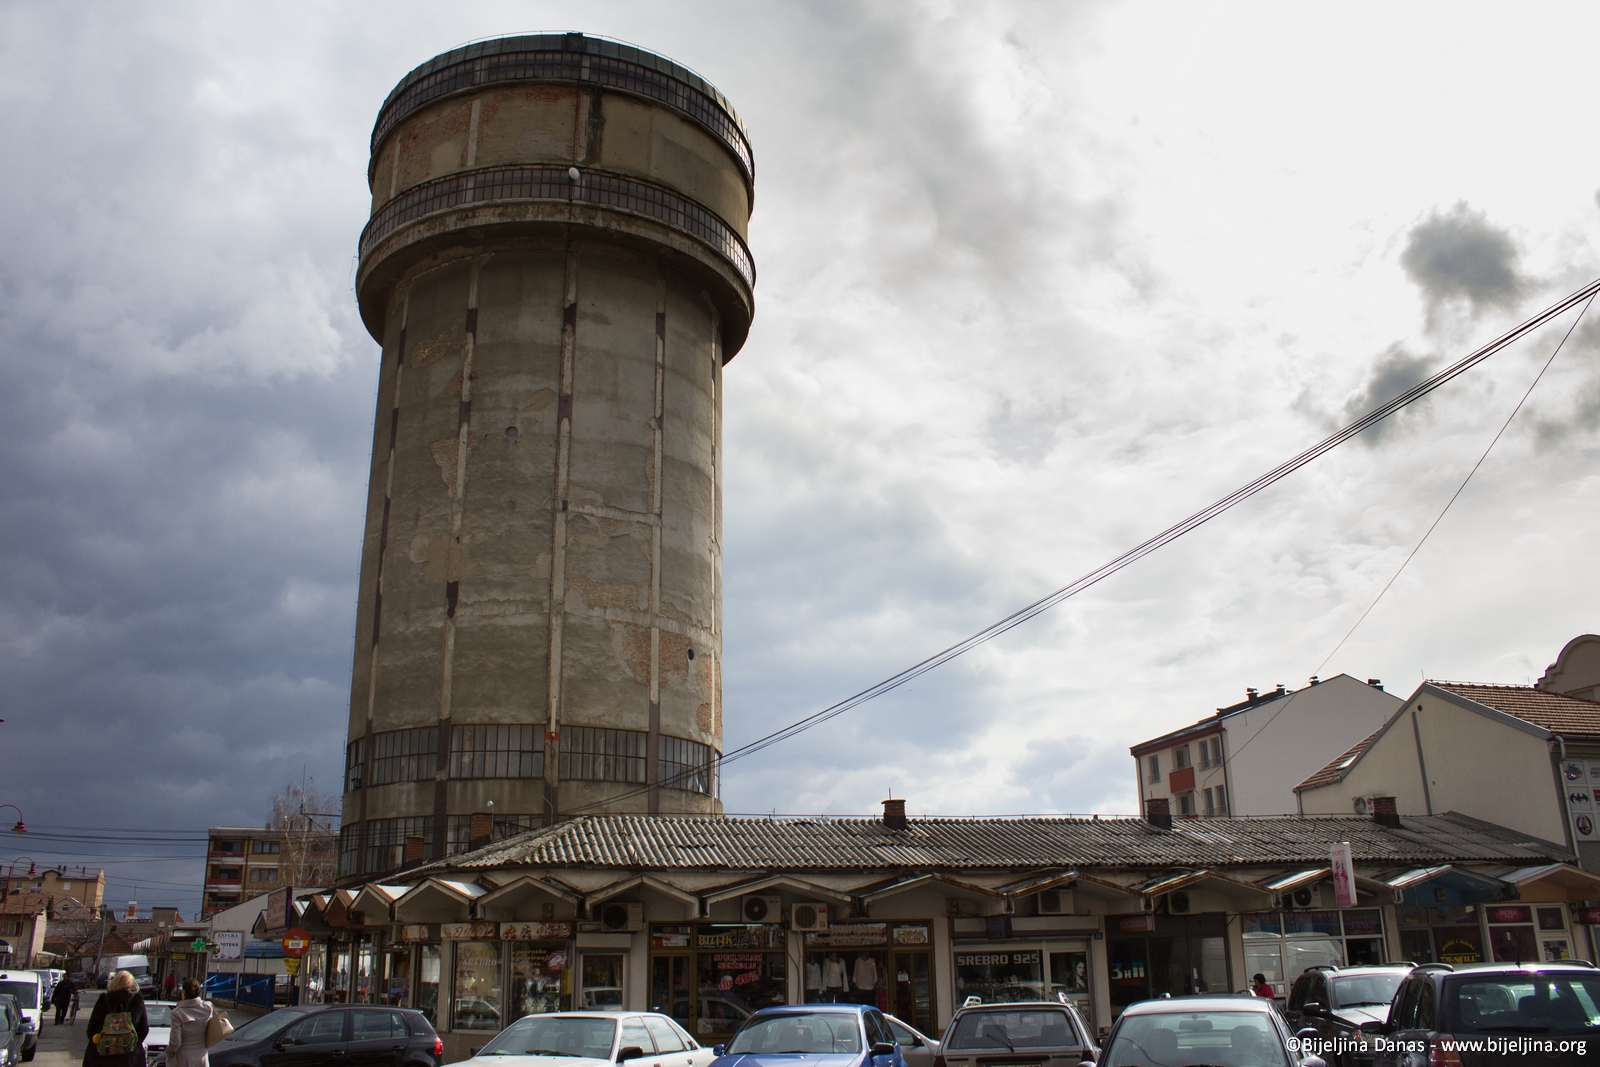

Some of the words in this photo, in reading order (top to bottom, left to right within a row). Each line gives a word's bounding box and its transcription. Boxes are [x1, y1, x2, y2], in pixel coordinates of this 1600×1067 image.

[463, 958, 498, 967] SREBRO
[957, 955, 1009, 966] SREBRO
[1013, 953, 1040, 964] 925
[719, 979, 733, 990] do
[735, 971, 760, 985] 40%
